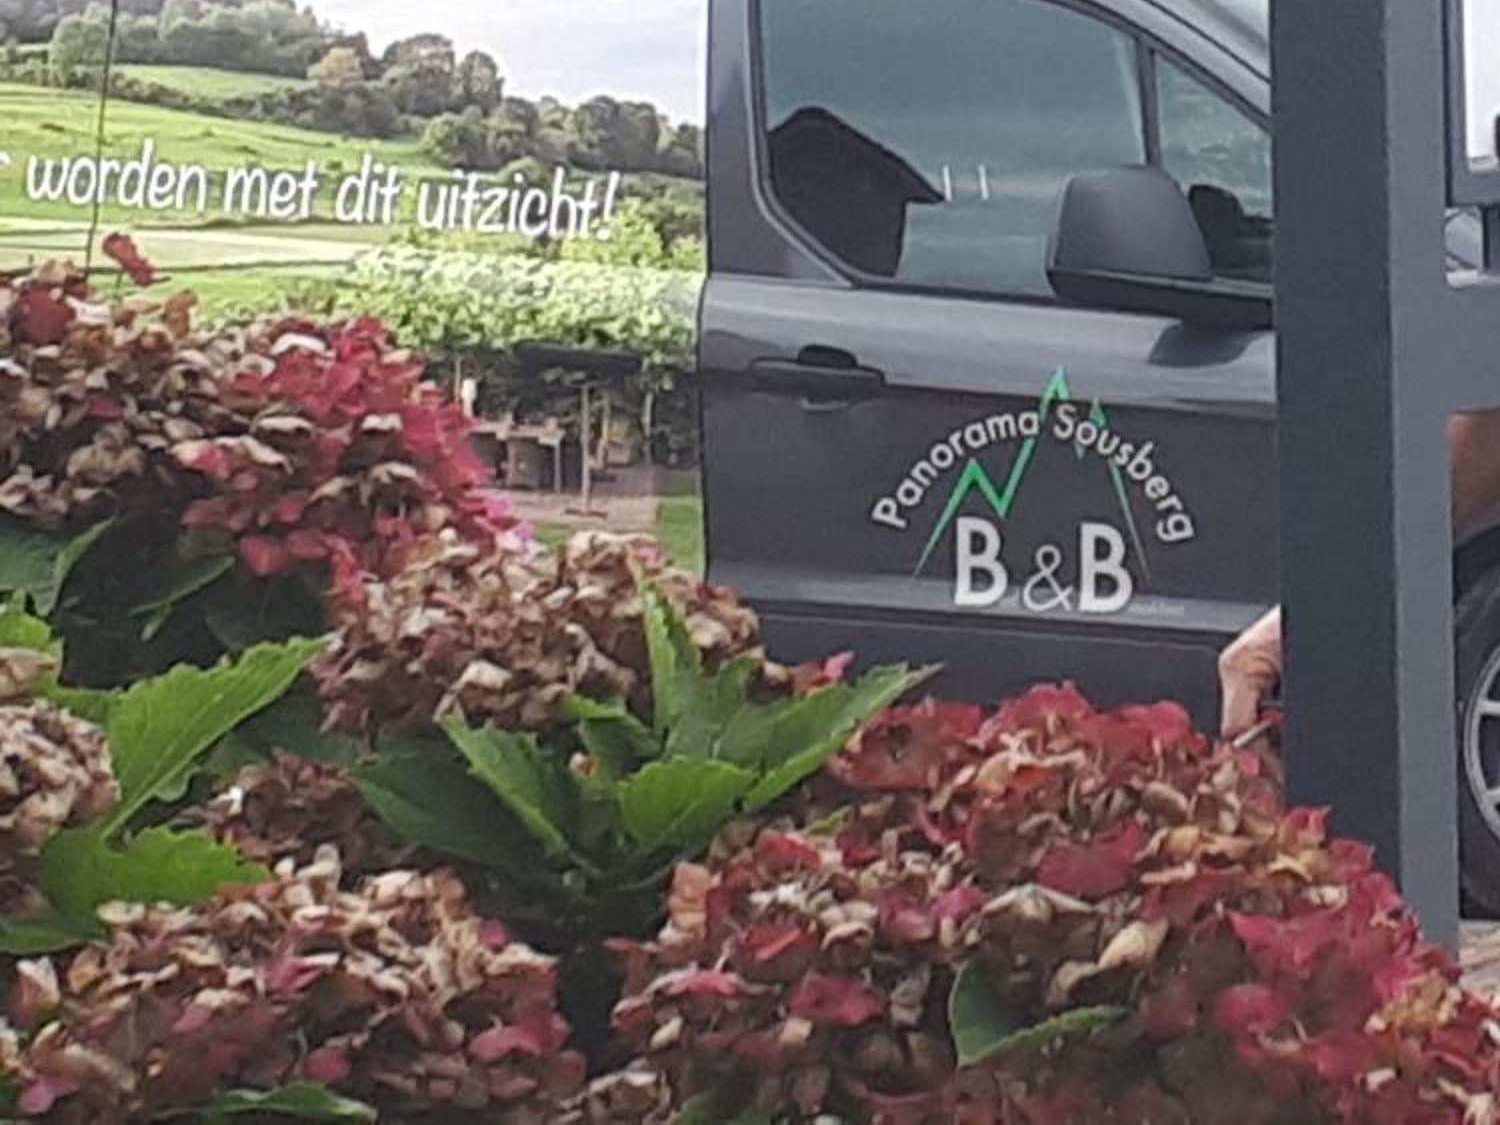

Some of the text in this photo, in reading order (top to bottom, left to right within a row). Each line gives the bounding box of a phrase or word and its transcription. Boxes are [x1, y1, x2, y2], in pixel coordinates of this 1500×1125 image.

[26, 137, 621, 241] worden met dit uitzicht!
[871, 402, 1196, 543] Panorama Sousberg
[953, 516, 1134, 613] B&B
